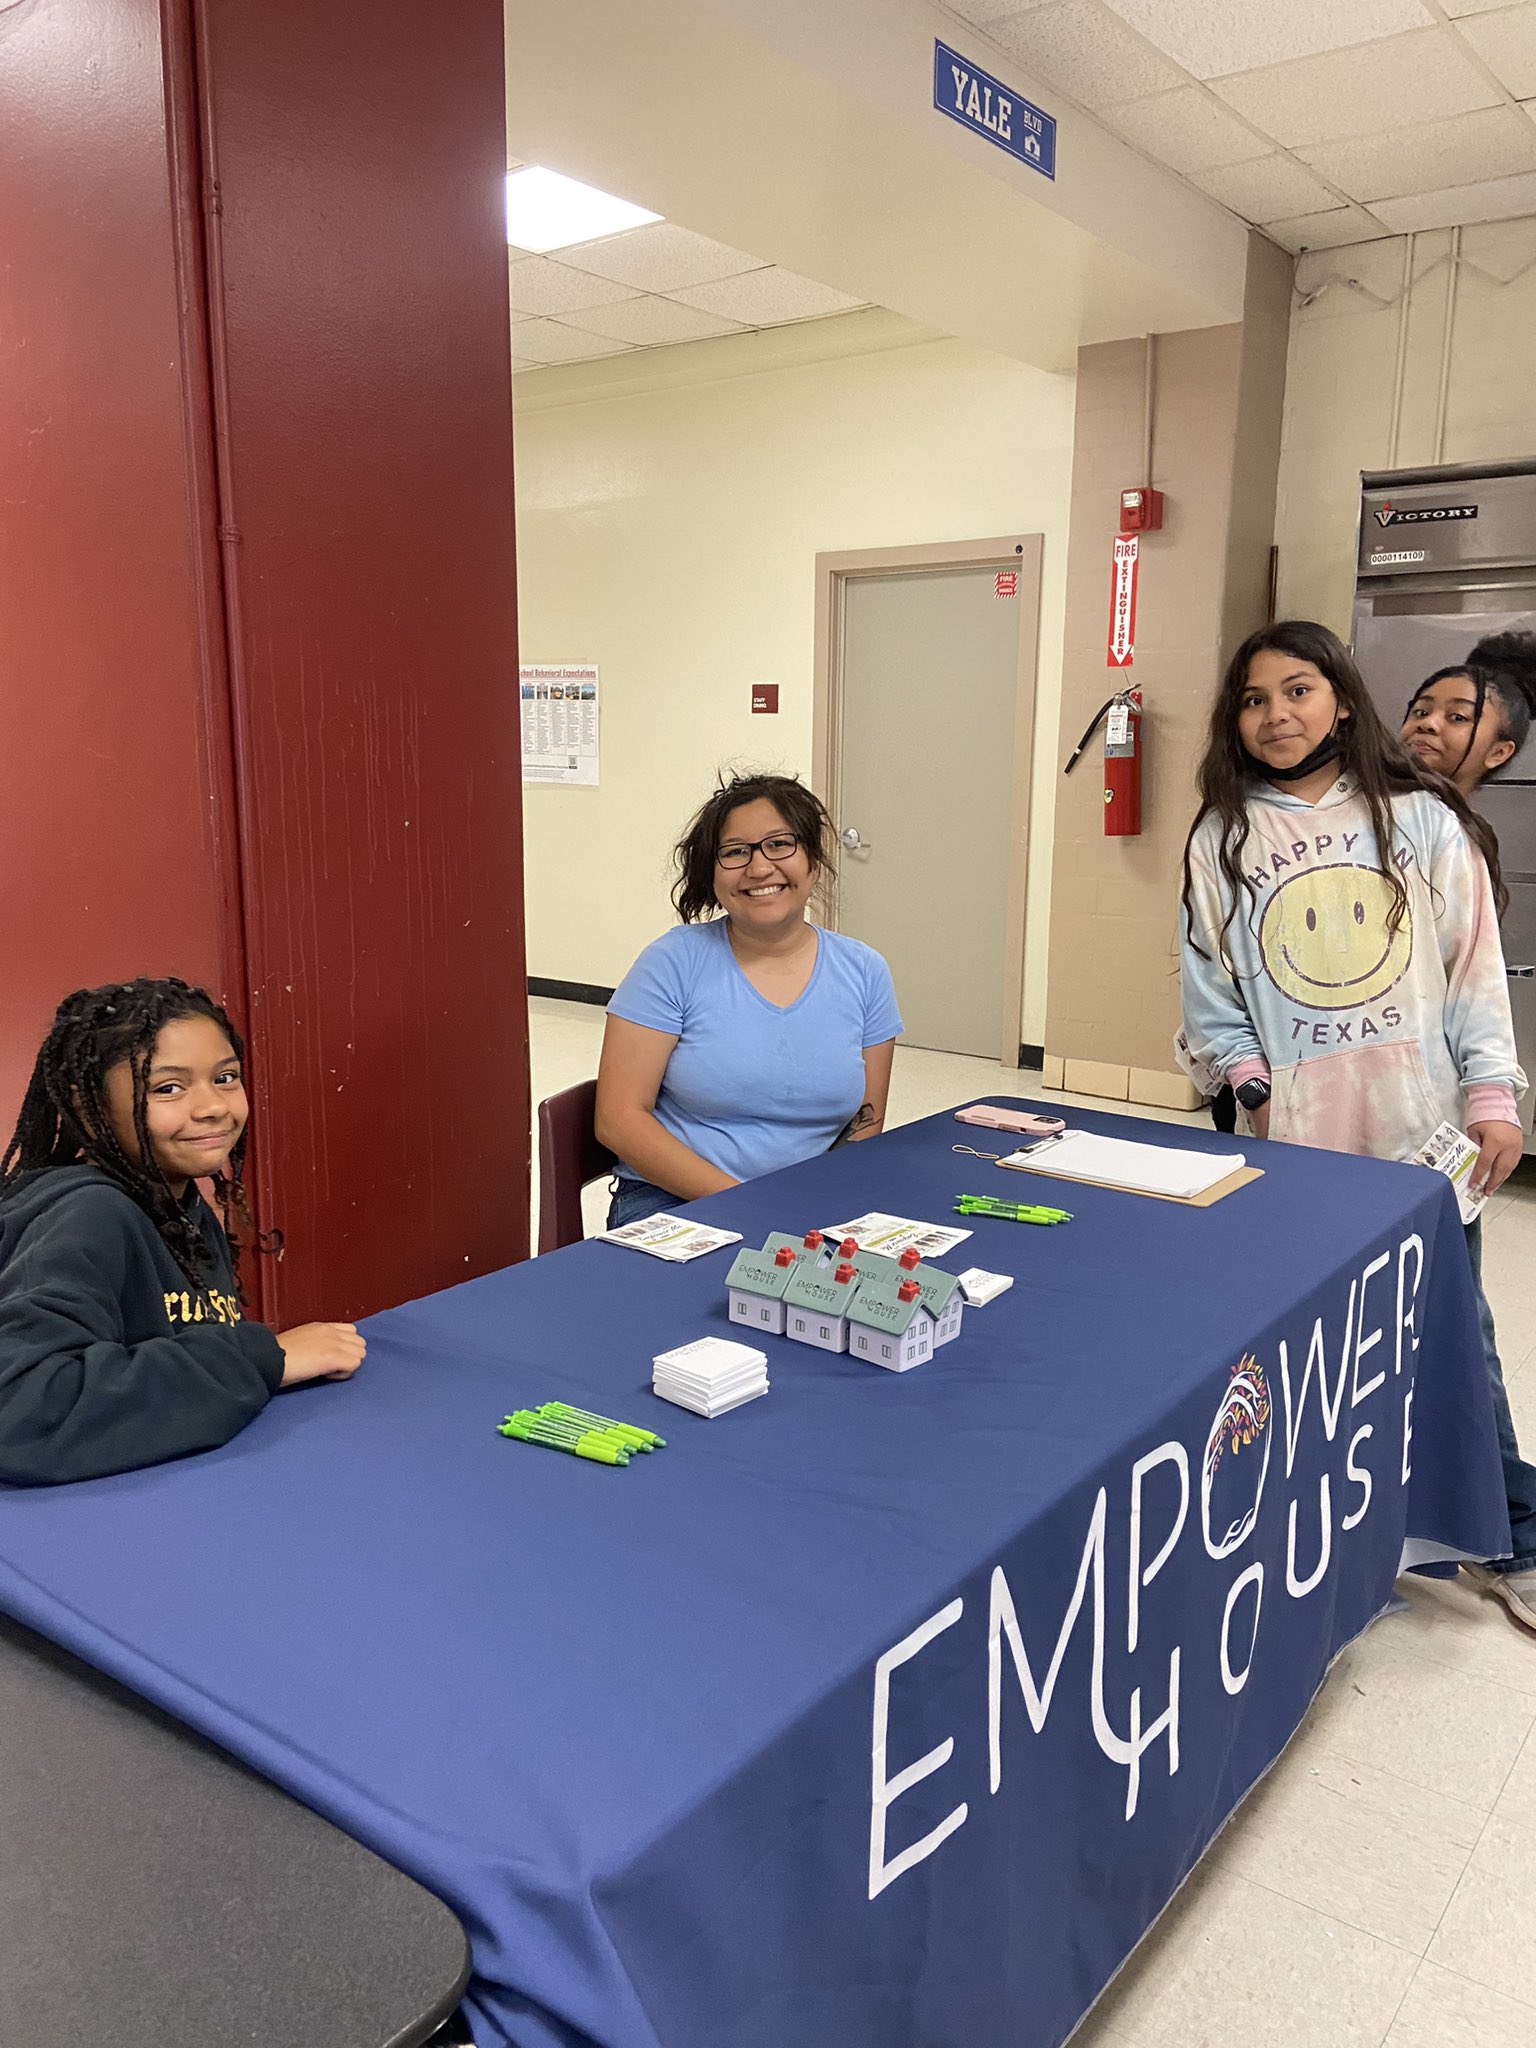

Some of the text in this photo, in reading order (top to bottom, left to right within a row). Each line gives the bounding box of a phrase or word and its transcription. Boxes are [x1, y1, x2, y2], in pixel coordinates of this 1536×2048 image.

[951, 65, 1012, 141] YALE
[1023, 110, 1043, 133] BLVD
[1115, 544, 1137, 558] FIRE
[1371, 551, 1424, 564] 0000114109
[1117, 560, 1129, 656] EXTINGUISHER
[535, 669, 563, 678] Behavioral
[563, 669, 596, 678] Expectations
[1247, 833, 1414, 889] HAPPY N
[1291, 1005, 1402, 1045] TEXAS
[738, 1264, 778, 1280] EMPOWER
[746, 1272, 775, 1285] HOUSE
[796, 1280, 838, 1296] EMPOWER
[805, 1289, 835, 1302] HOUSE
[859, 1296, 901, 1315] EMPOWER
[868, 1306, 898, 1321] HOUSE
[869, 1234, 1424, 1900] EMPOWER
